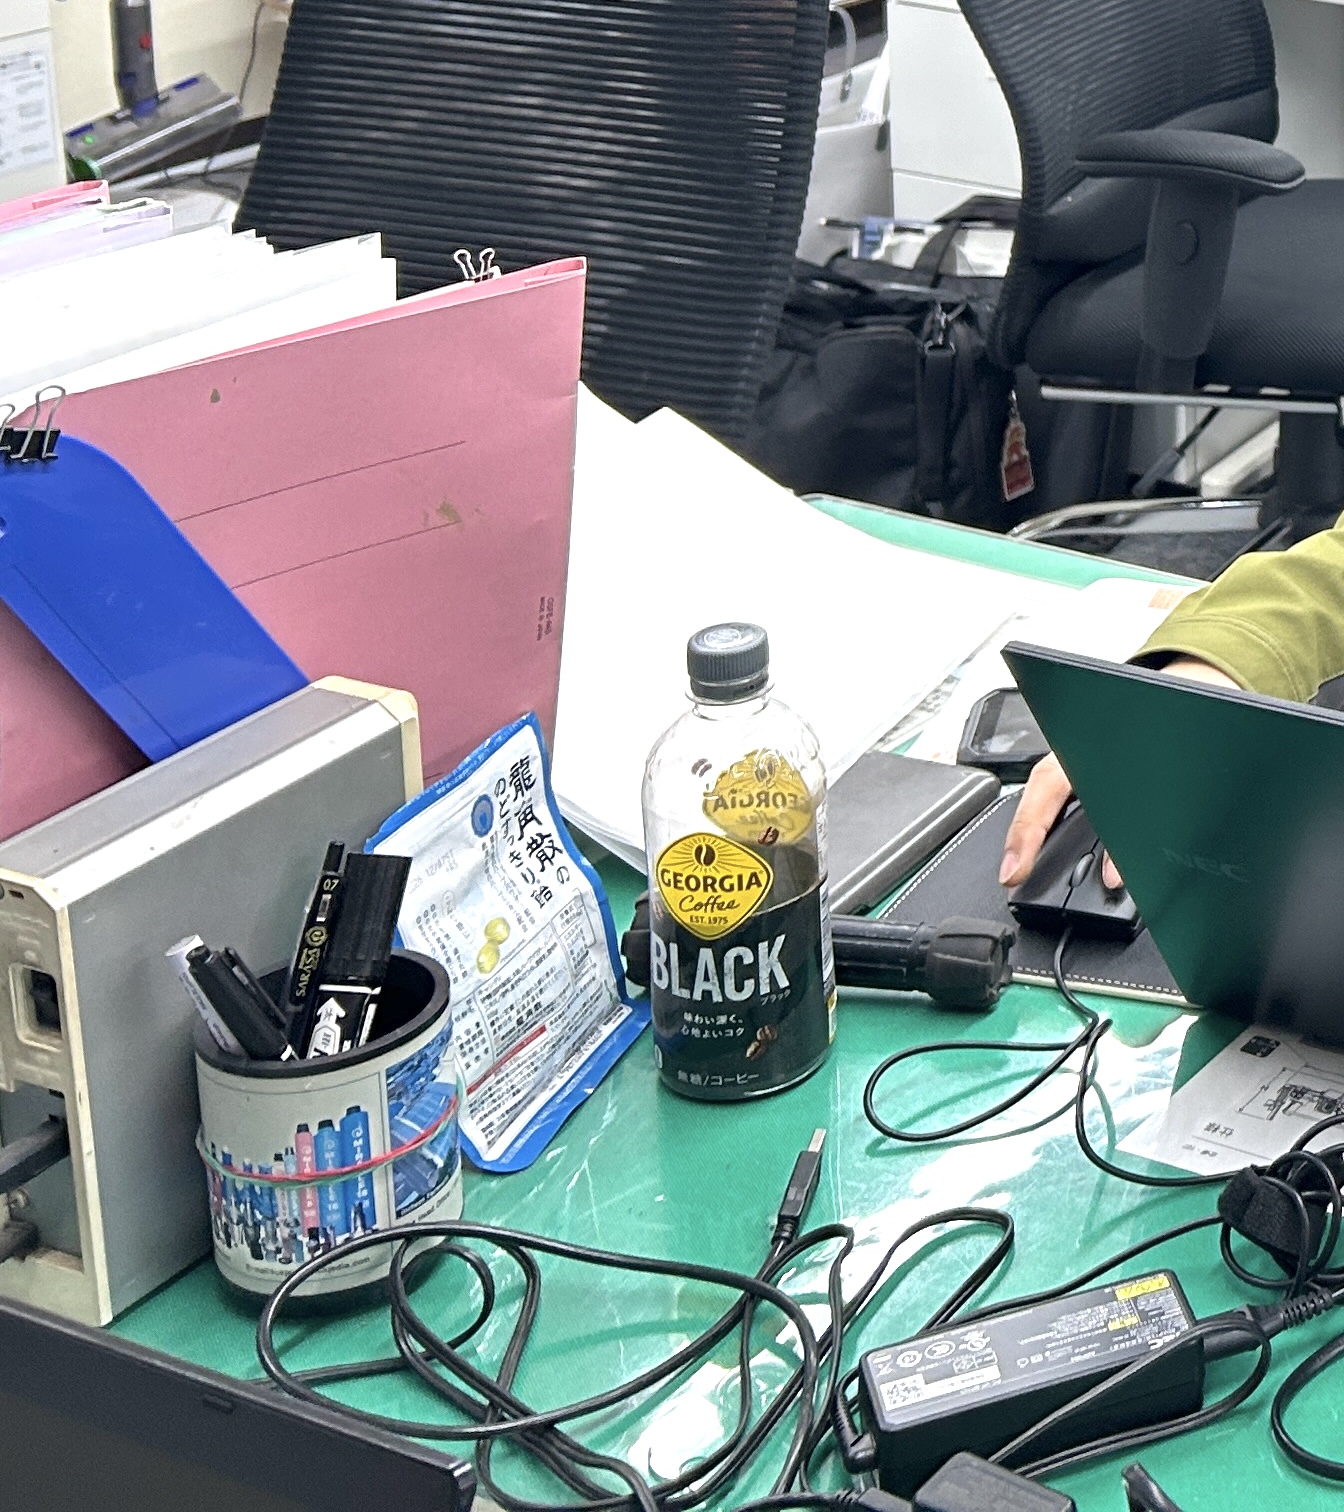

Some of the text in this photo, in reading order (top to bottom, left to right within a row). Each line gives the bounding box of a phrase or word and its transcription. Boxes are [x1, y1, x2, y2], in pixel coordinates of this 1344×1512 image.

[509, 755, 570, 885] 龍角散の
[660, 868, 763, 893] GEORGIA
[679, 895, 741, 913] Coffee
[690, 915, 729, 925] EST. 1975
[651, 930, 790, 1004] BLACK
